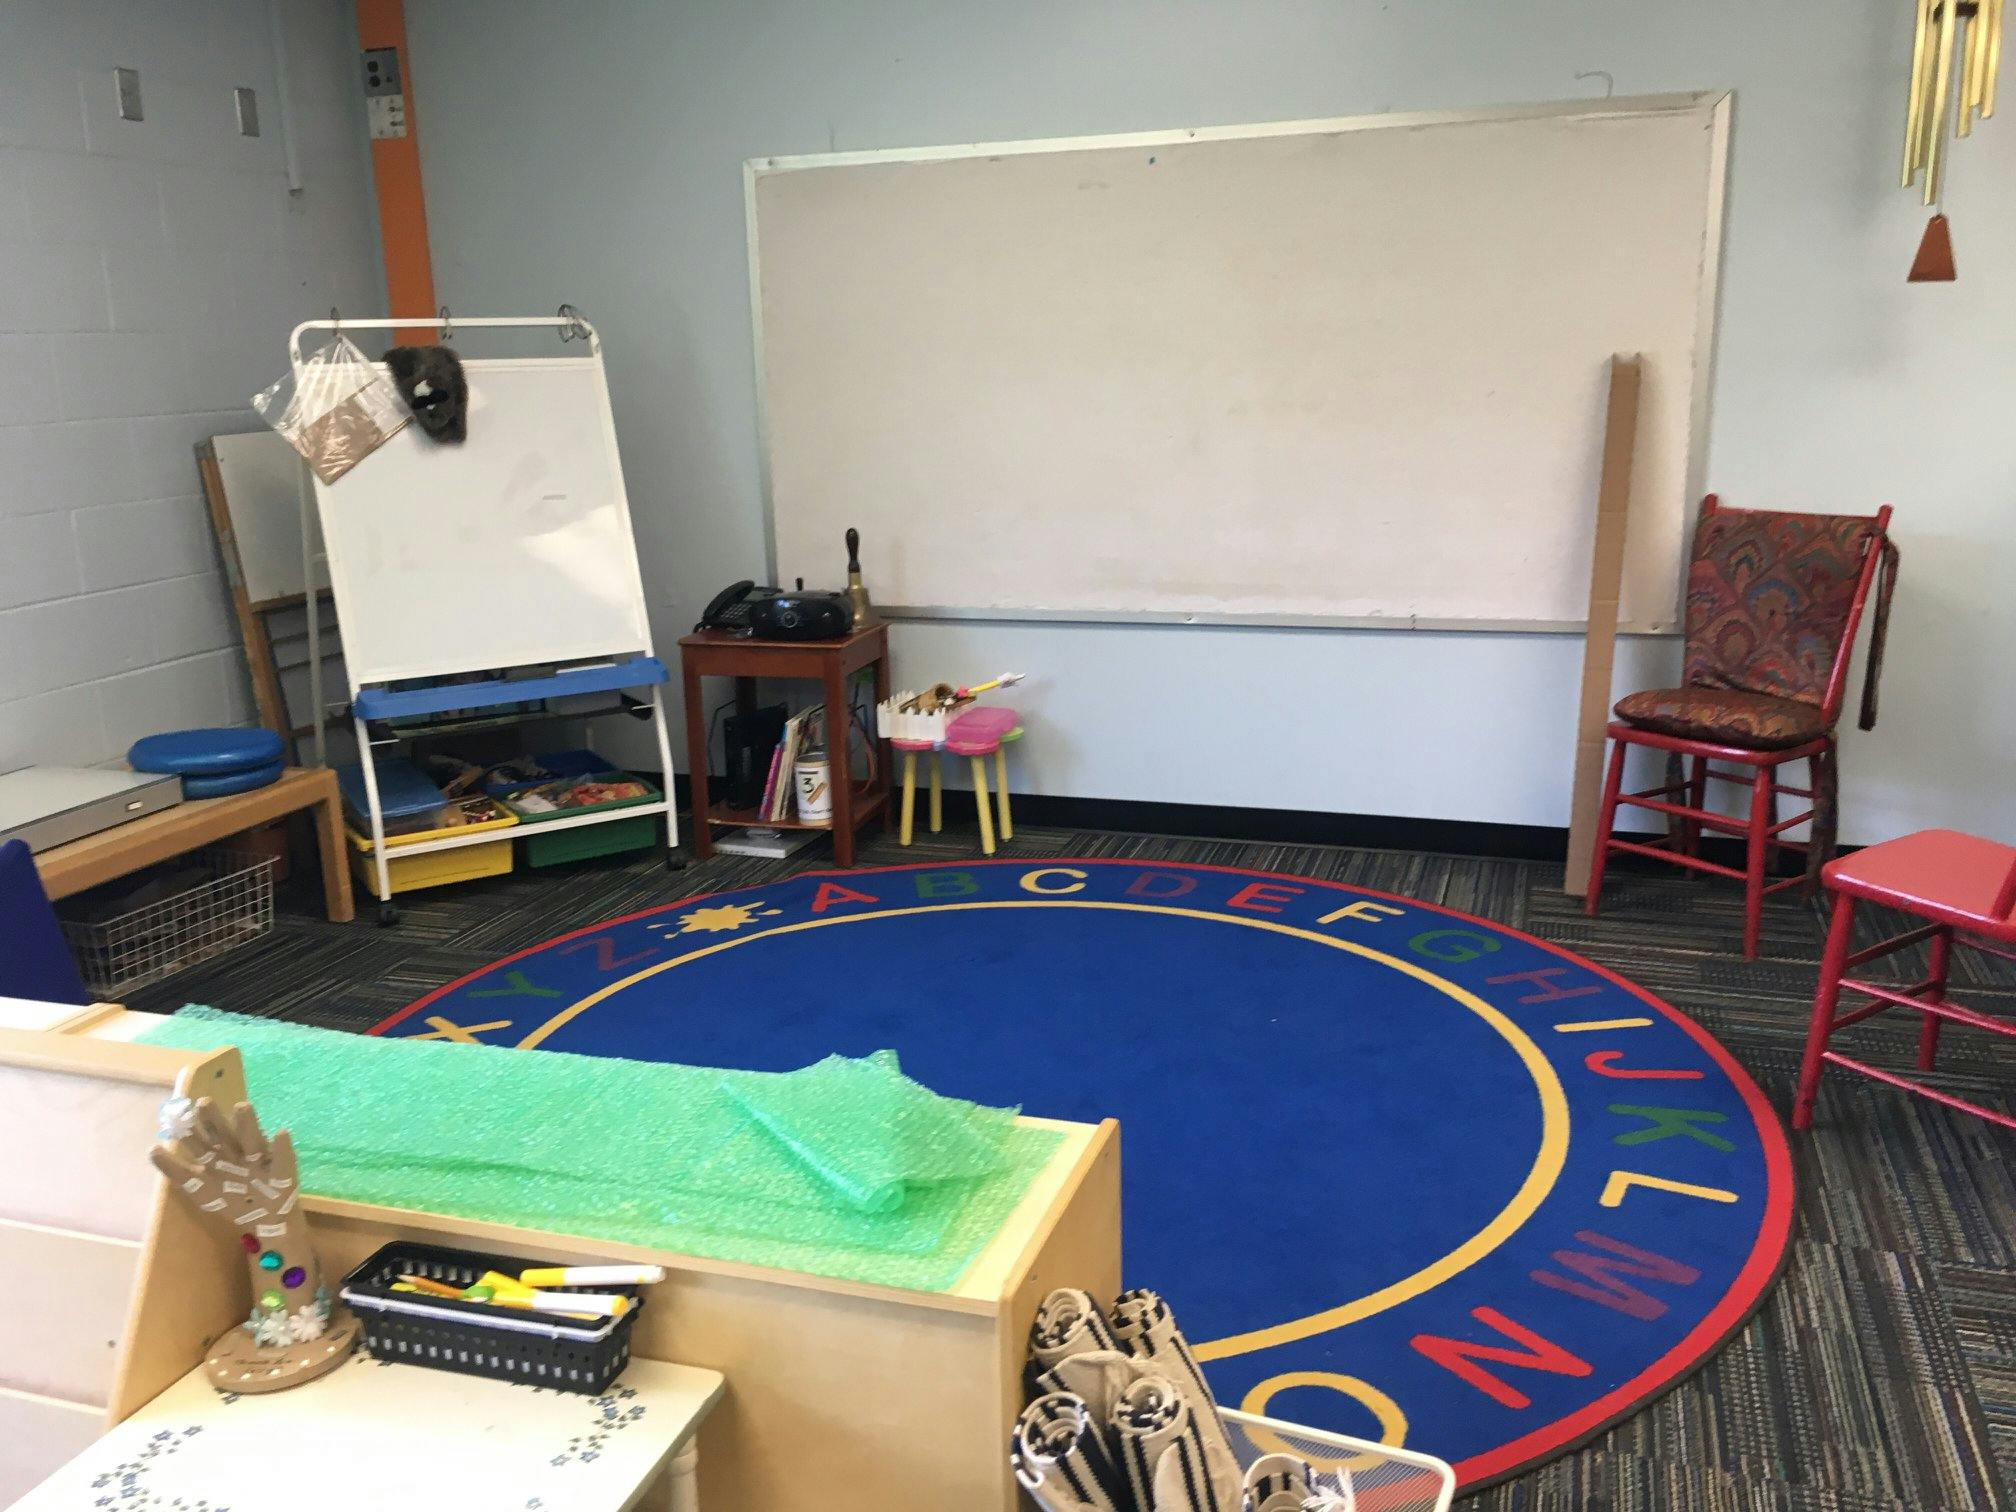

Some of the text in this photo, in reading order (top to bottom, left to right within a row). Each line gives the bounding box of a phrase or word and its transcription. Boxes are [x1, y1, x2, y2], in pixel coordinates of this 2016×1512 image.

[802, 777, 815, 794] 3
[398, 937, 660, 1044] X Y Z
[811, 869, 1738, 1473] A B C D E F G H I J K L M N O
